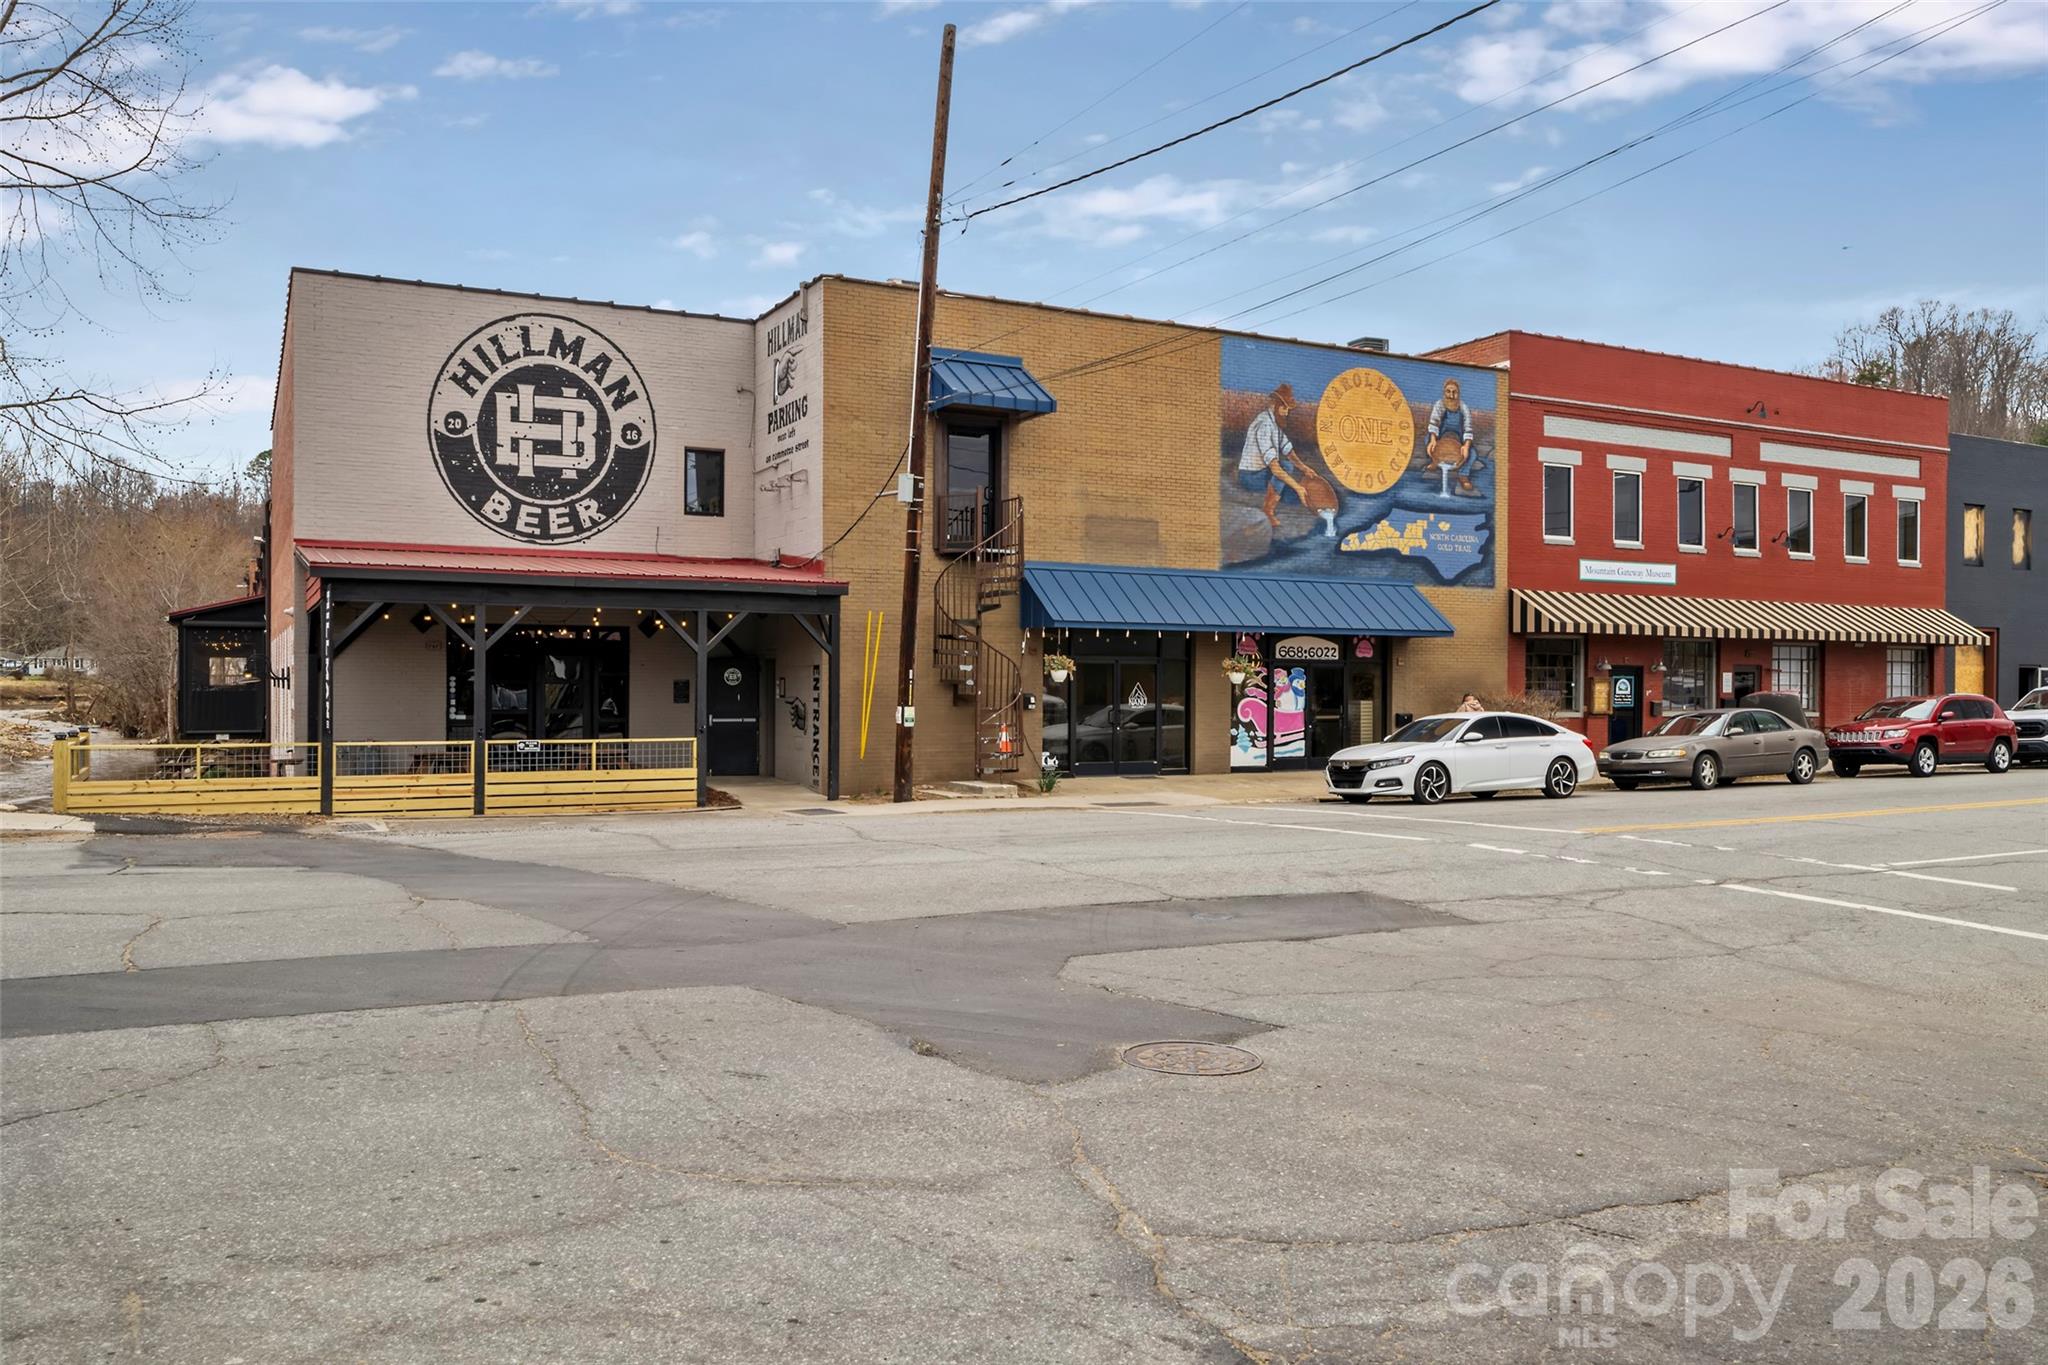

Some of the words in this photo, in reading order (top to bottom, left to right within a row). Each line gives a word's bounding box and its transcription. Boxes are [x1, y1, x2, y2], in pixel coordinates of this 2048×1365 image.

[767, 311, 808, 357] HILLMAN
[449, 325, 639, 411] HILLMAN
[447, 416, 462, 430] 20
[625, 429, 639, 441] 16
[767, 393, 808, 435] PARKING
[1339, 414, 1393, 445] ONE
[480, 490, 606, 534] BEER
[1430, 532, 1450, 541] NORTH
[1450, 534, 1480, 543] CAROLINA
[1437, 543, 1453, 551] GOLD
[1455, 544, 1472, 552] TRAIL
[1584, 565, 1616, 576] Mountain
[1616, 567, 1644, 579] Gateway
[1645, 568, 1672, 578] Museum
[812, 664, 820, 777] ENTRANCE
